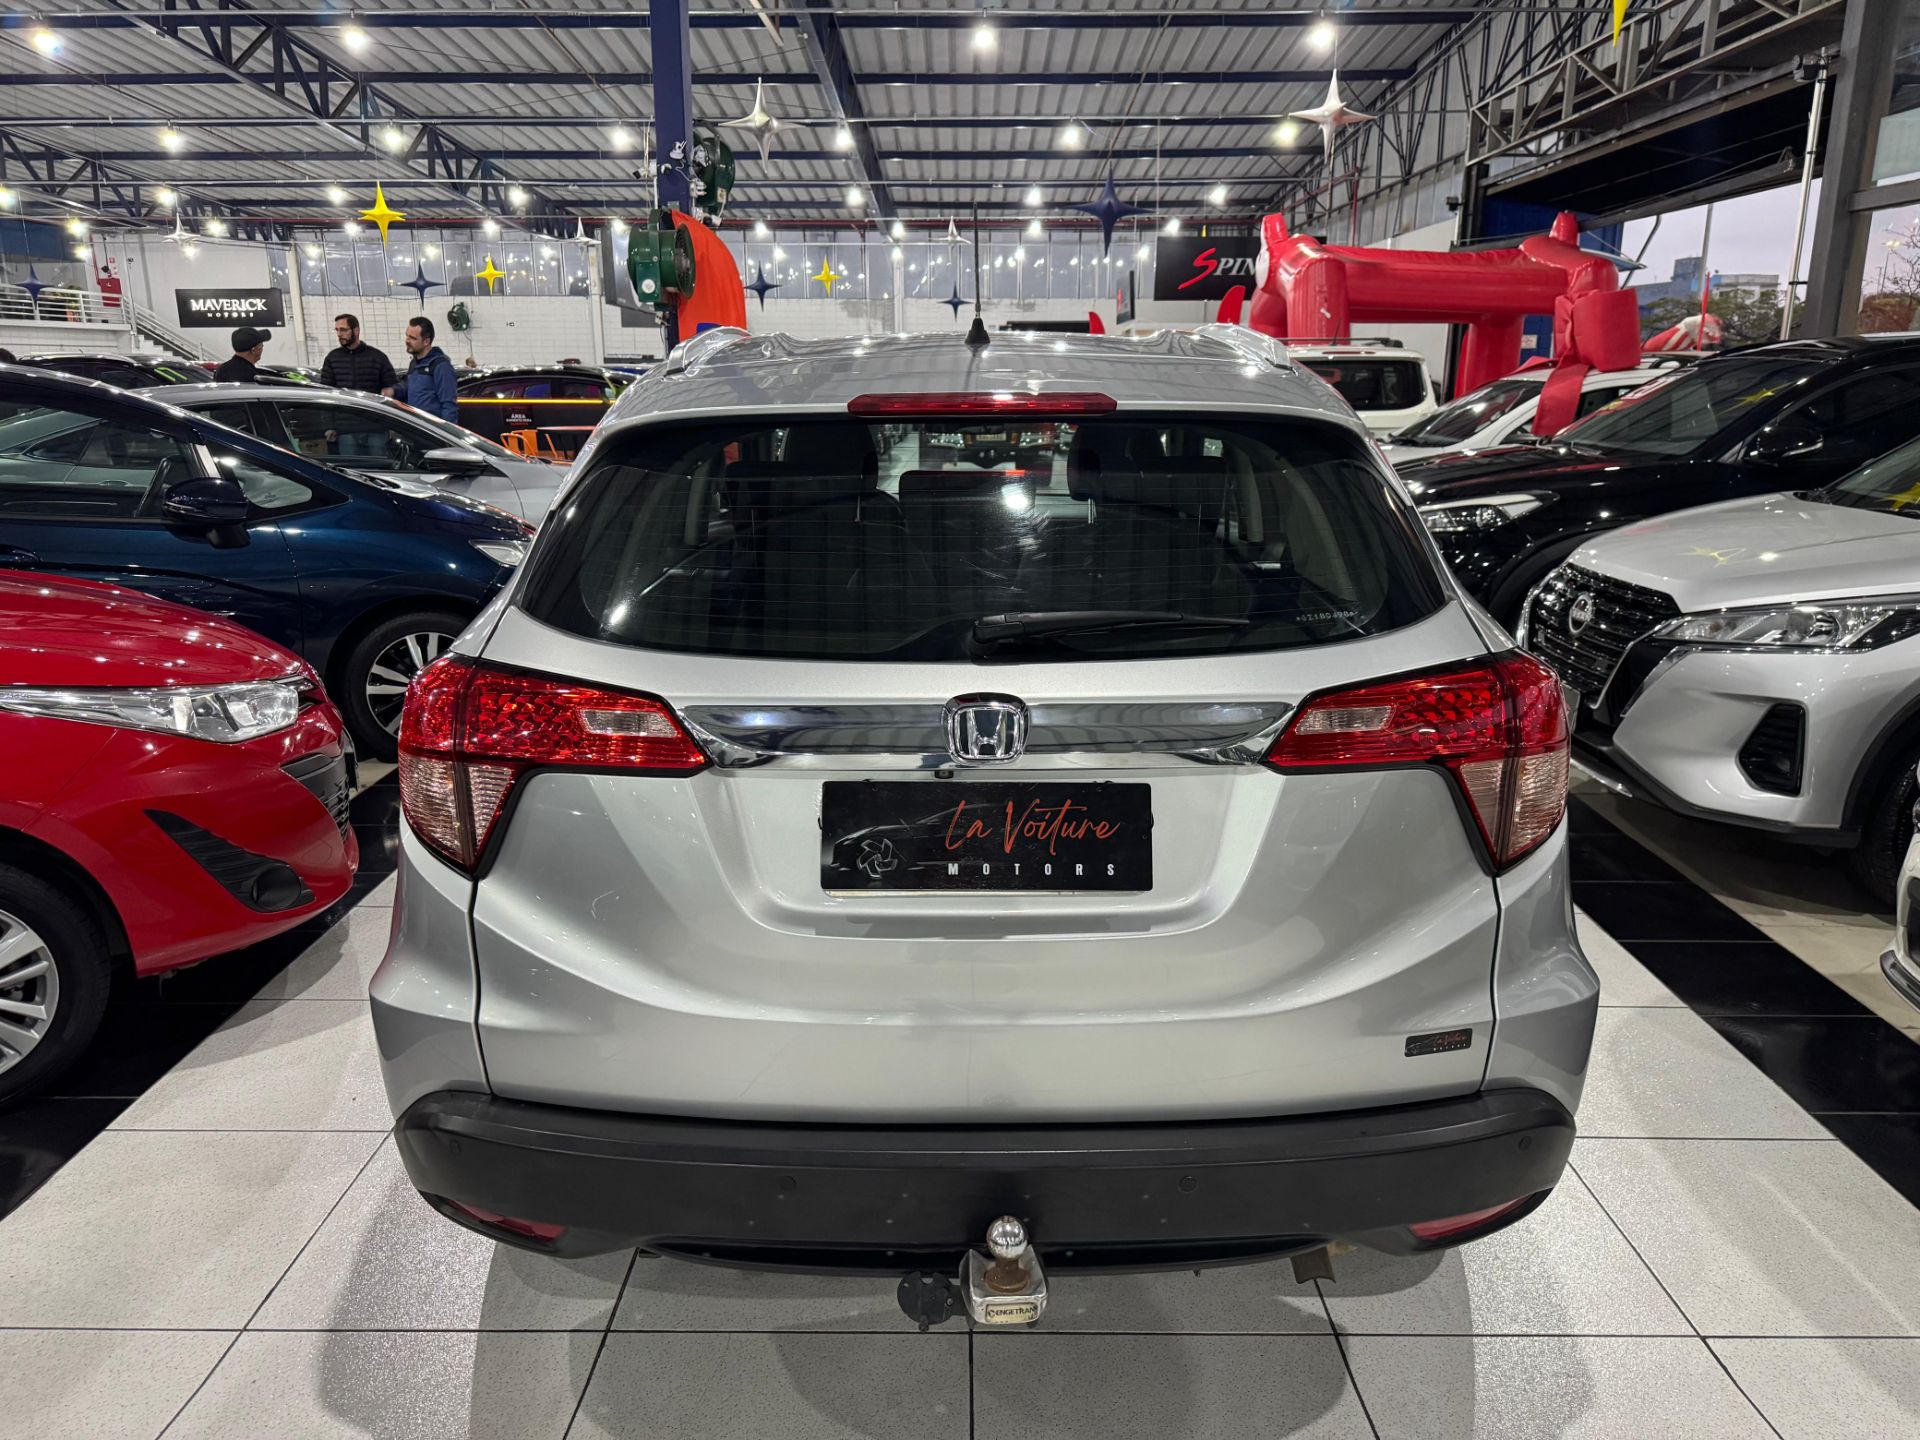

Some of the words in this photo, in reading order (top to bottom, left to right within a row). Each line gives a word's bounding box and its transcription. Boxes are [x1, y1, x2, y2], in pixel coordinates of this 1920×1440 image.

[190, 299, 267, 311] MAVERICK
[945, 799, 993, 850] La
[1003, 798, 1121, 857] Voiture
[948, 863, 1115, 876] MOTORS
